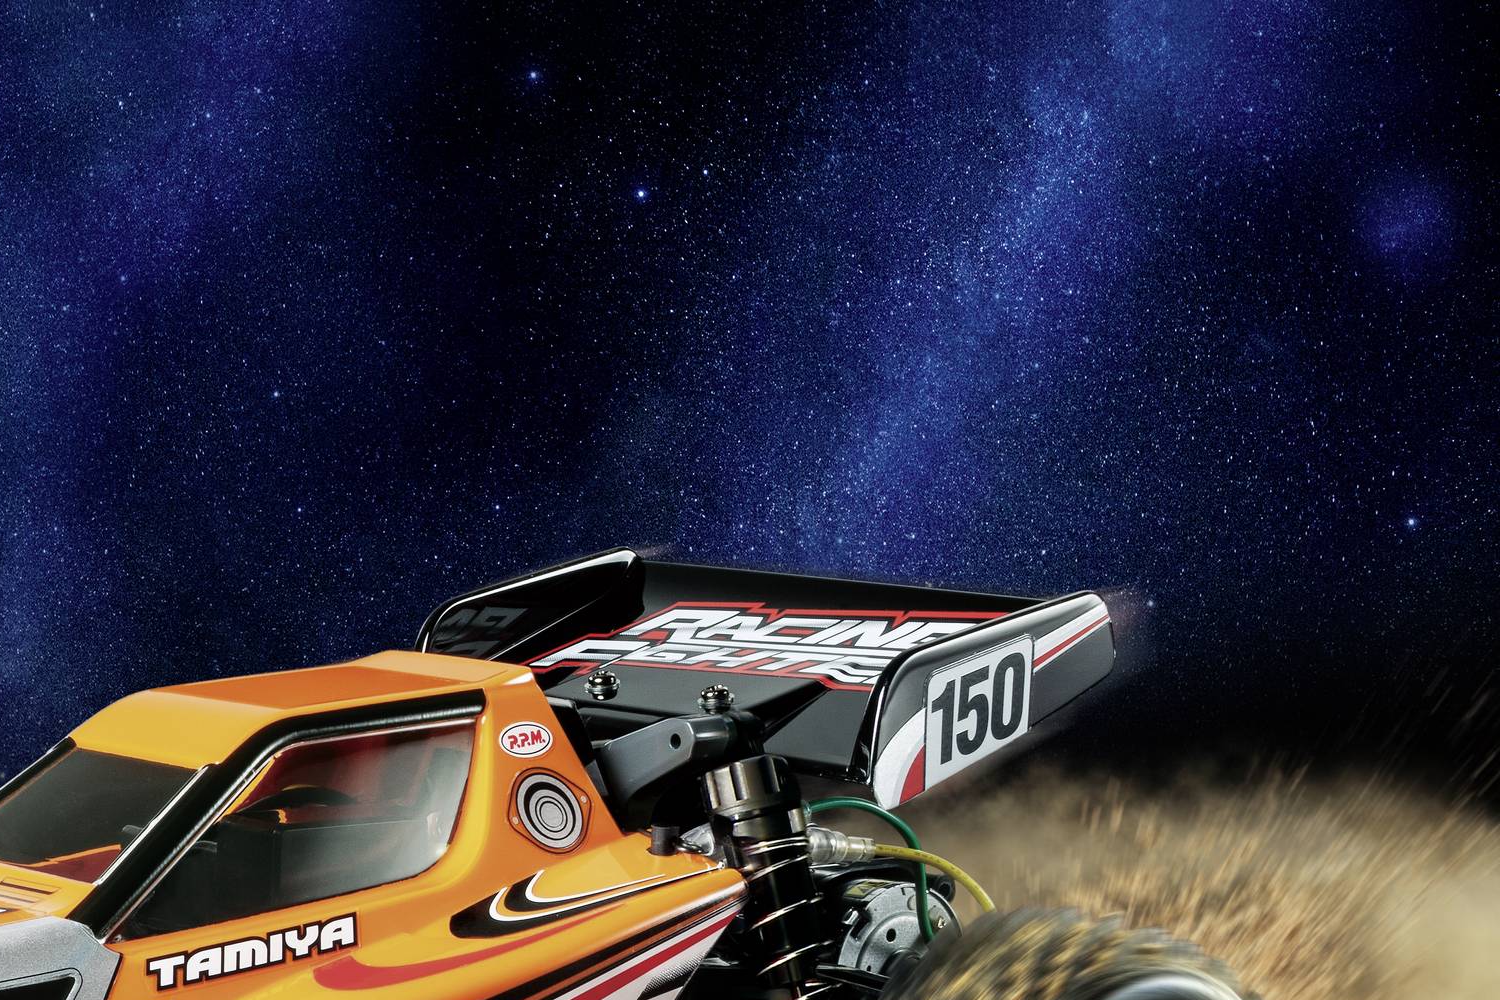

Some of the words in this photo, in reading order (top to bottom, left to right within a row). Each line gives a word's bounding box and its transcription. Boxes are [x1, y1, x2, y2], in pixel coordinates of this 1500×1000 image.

[529, 640, 893, 684] FIGHTE
[931, 652, 1026, 765] 150
[148, 914, 356, 988] TAMIYA
